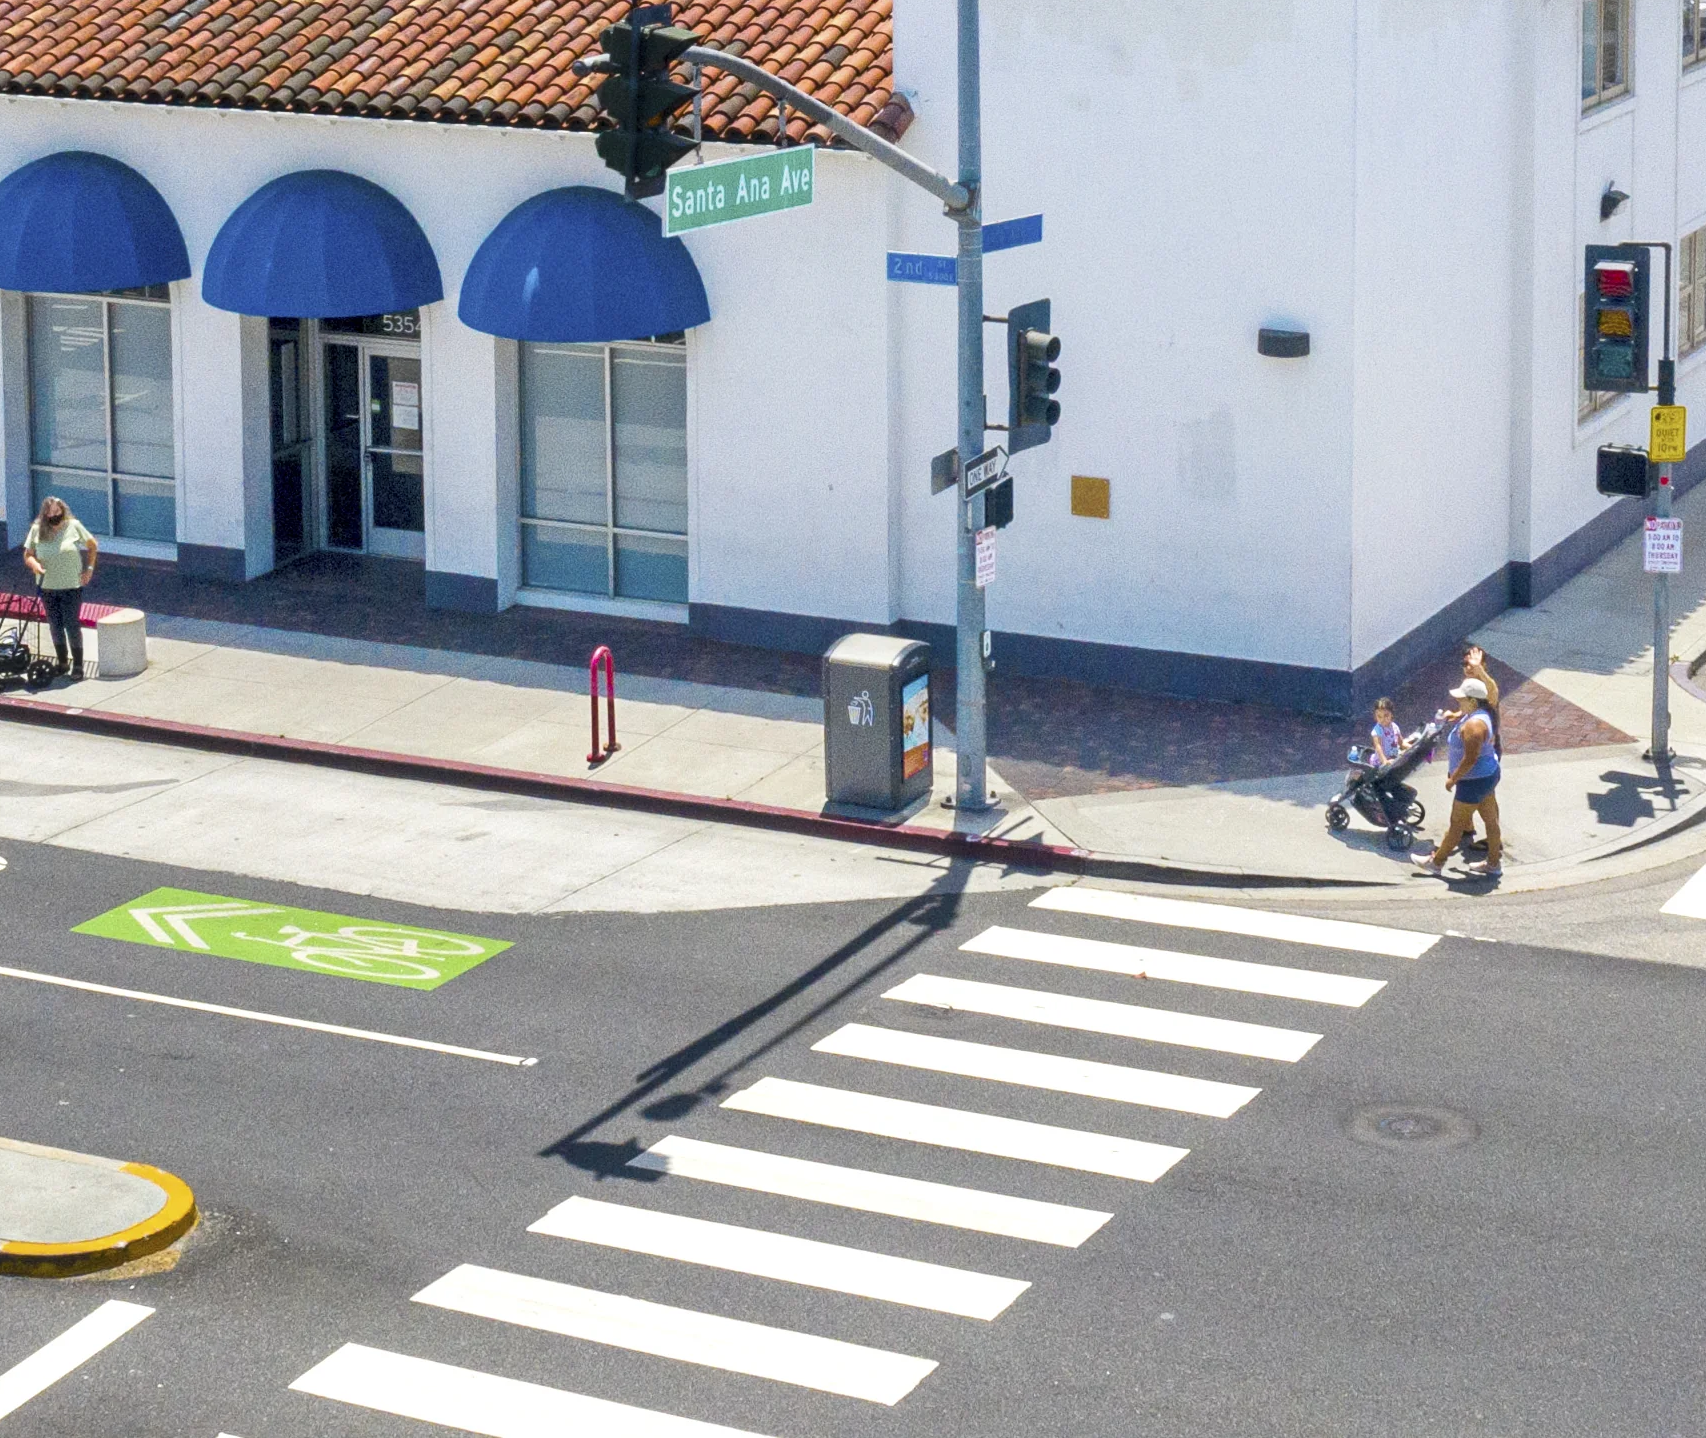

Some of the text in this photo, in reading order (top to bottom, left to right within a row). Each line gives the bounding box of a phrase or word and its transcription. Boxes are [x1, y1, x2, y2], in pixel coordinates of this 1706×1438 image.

[672, 164, 810, 217] Santa Ana Ave
[894, 259, 923, 275] 2nd
[1656, 428, 1679, 438] QUIET
[970, 459, 997, 486] ONE WAY
